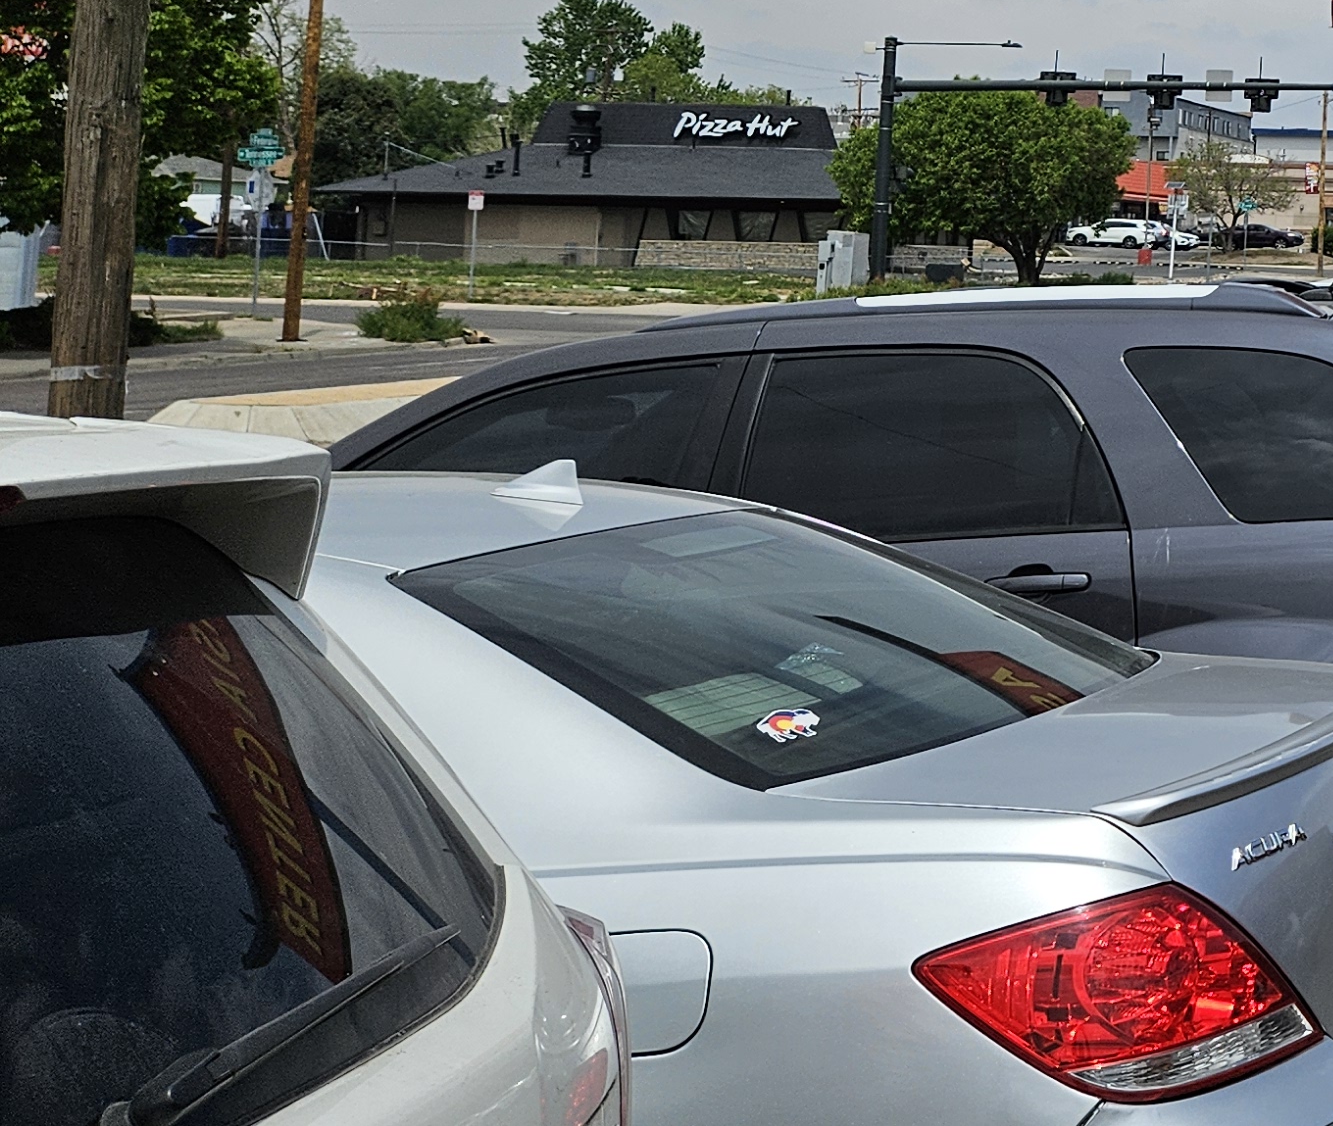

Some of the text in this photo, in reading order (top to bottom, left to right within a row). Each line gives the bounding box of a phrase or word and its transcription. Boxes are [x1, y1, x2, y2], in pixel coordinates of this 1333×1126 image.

[673, 111, 799, 138] Pizza Hut
[1230, 823, 1308, 872] ACURA
